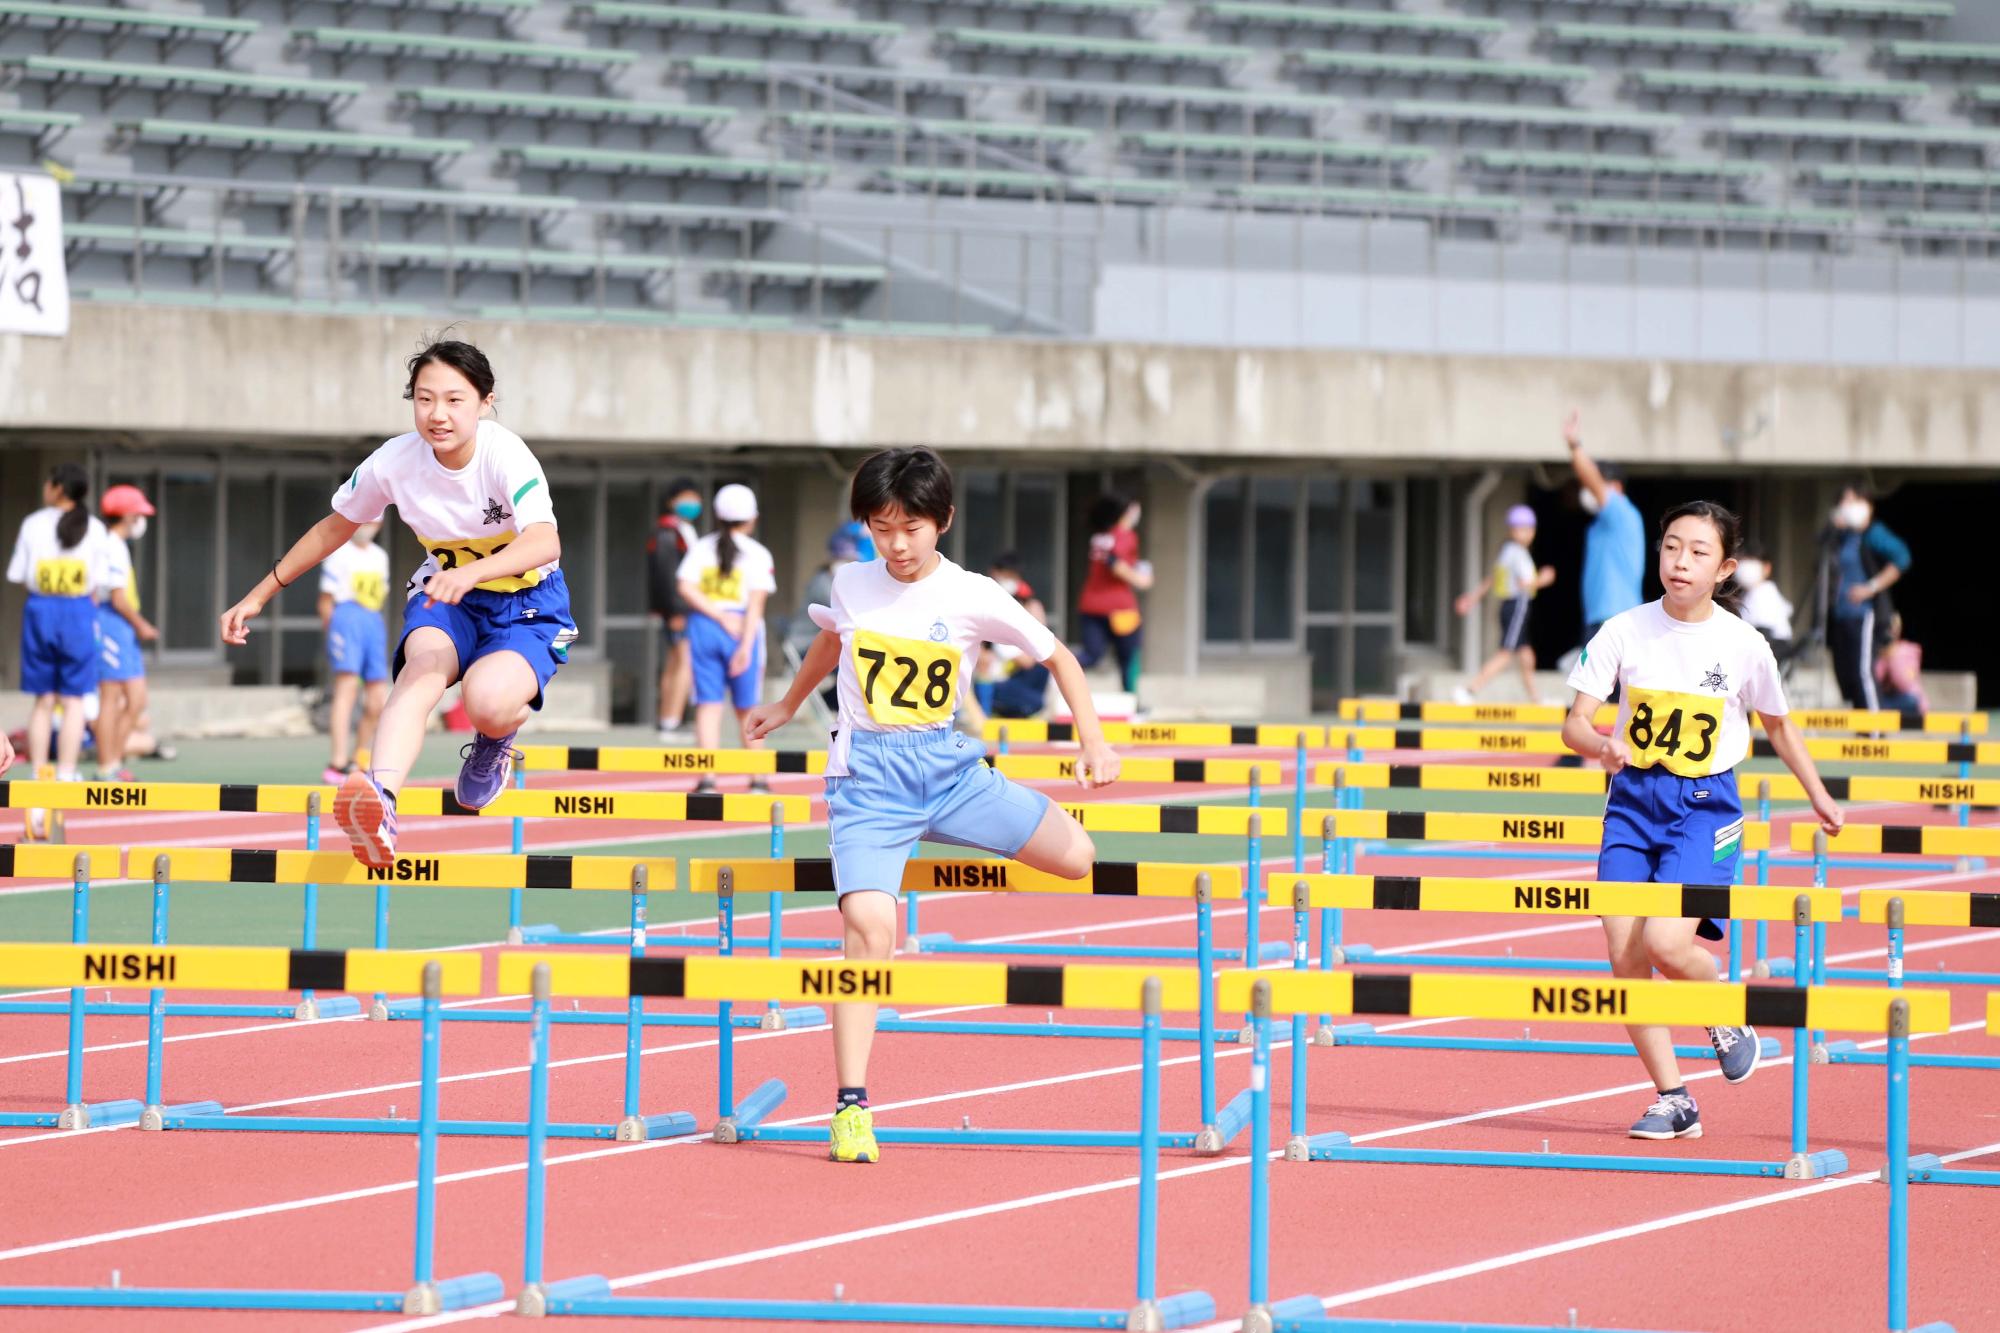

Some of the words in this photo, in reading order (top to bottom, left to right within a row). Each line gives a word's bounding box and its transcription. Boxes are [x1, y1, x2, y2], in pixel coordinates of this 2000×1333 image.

[857, 647, 953, 710] 728
[1131, 728, 1177, 741] NISHI
[1480, 735, 1527, 748] NISHI
[1629, 702, 1718, 762] 843
[663, 752, 715, 769] NISHI
[1842, 744, 1890, 758] NISHI
[1488, 771, 1540, 788] NISHI
[86, 786, 148, 807] NISHI
[1919, 783, 1975, 800] NISHI
[554, 795, 615, 815] NISHI
[933, 864, 1008, 889] NISHI
[1514, 885, 1590, 910] NISHI
[85, 953, 175, 982] NISHI
[802, 968, 892, 996] NISHI
[1532, 987, 1627, 1015] NISHI
